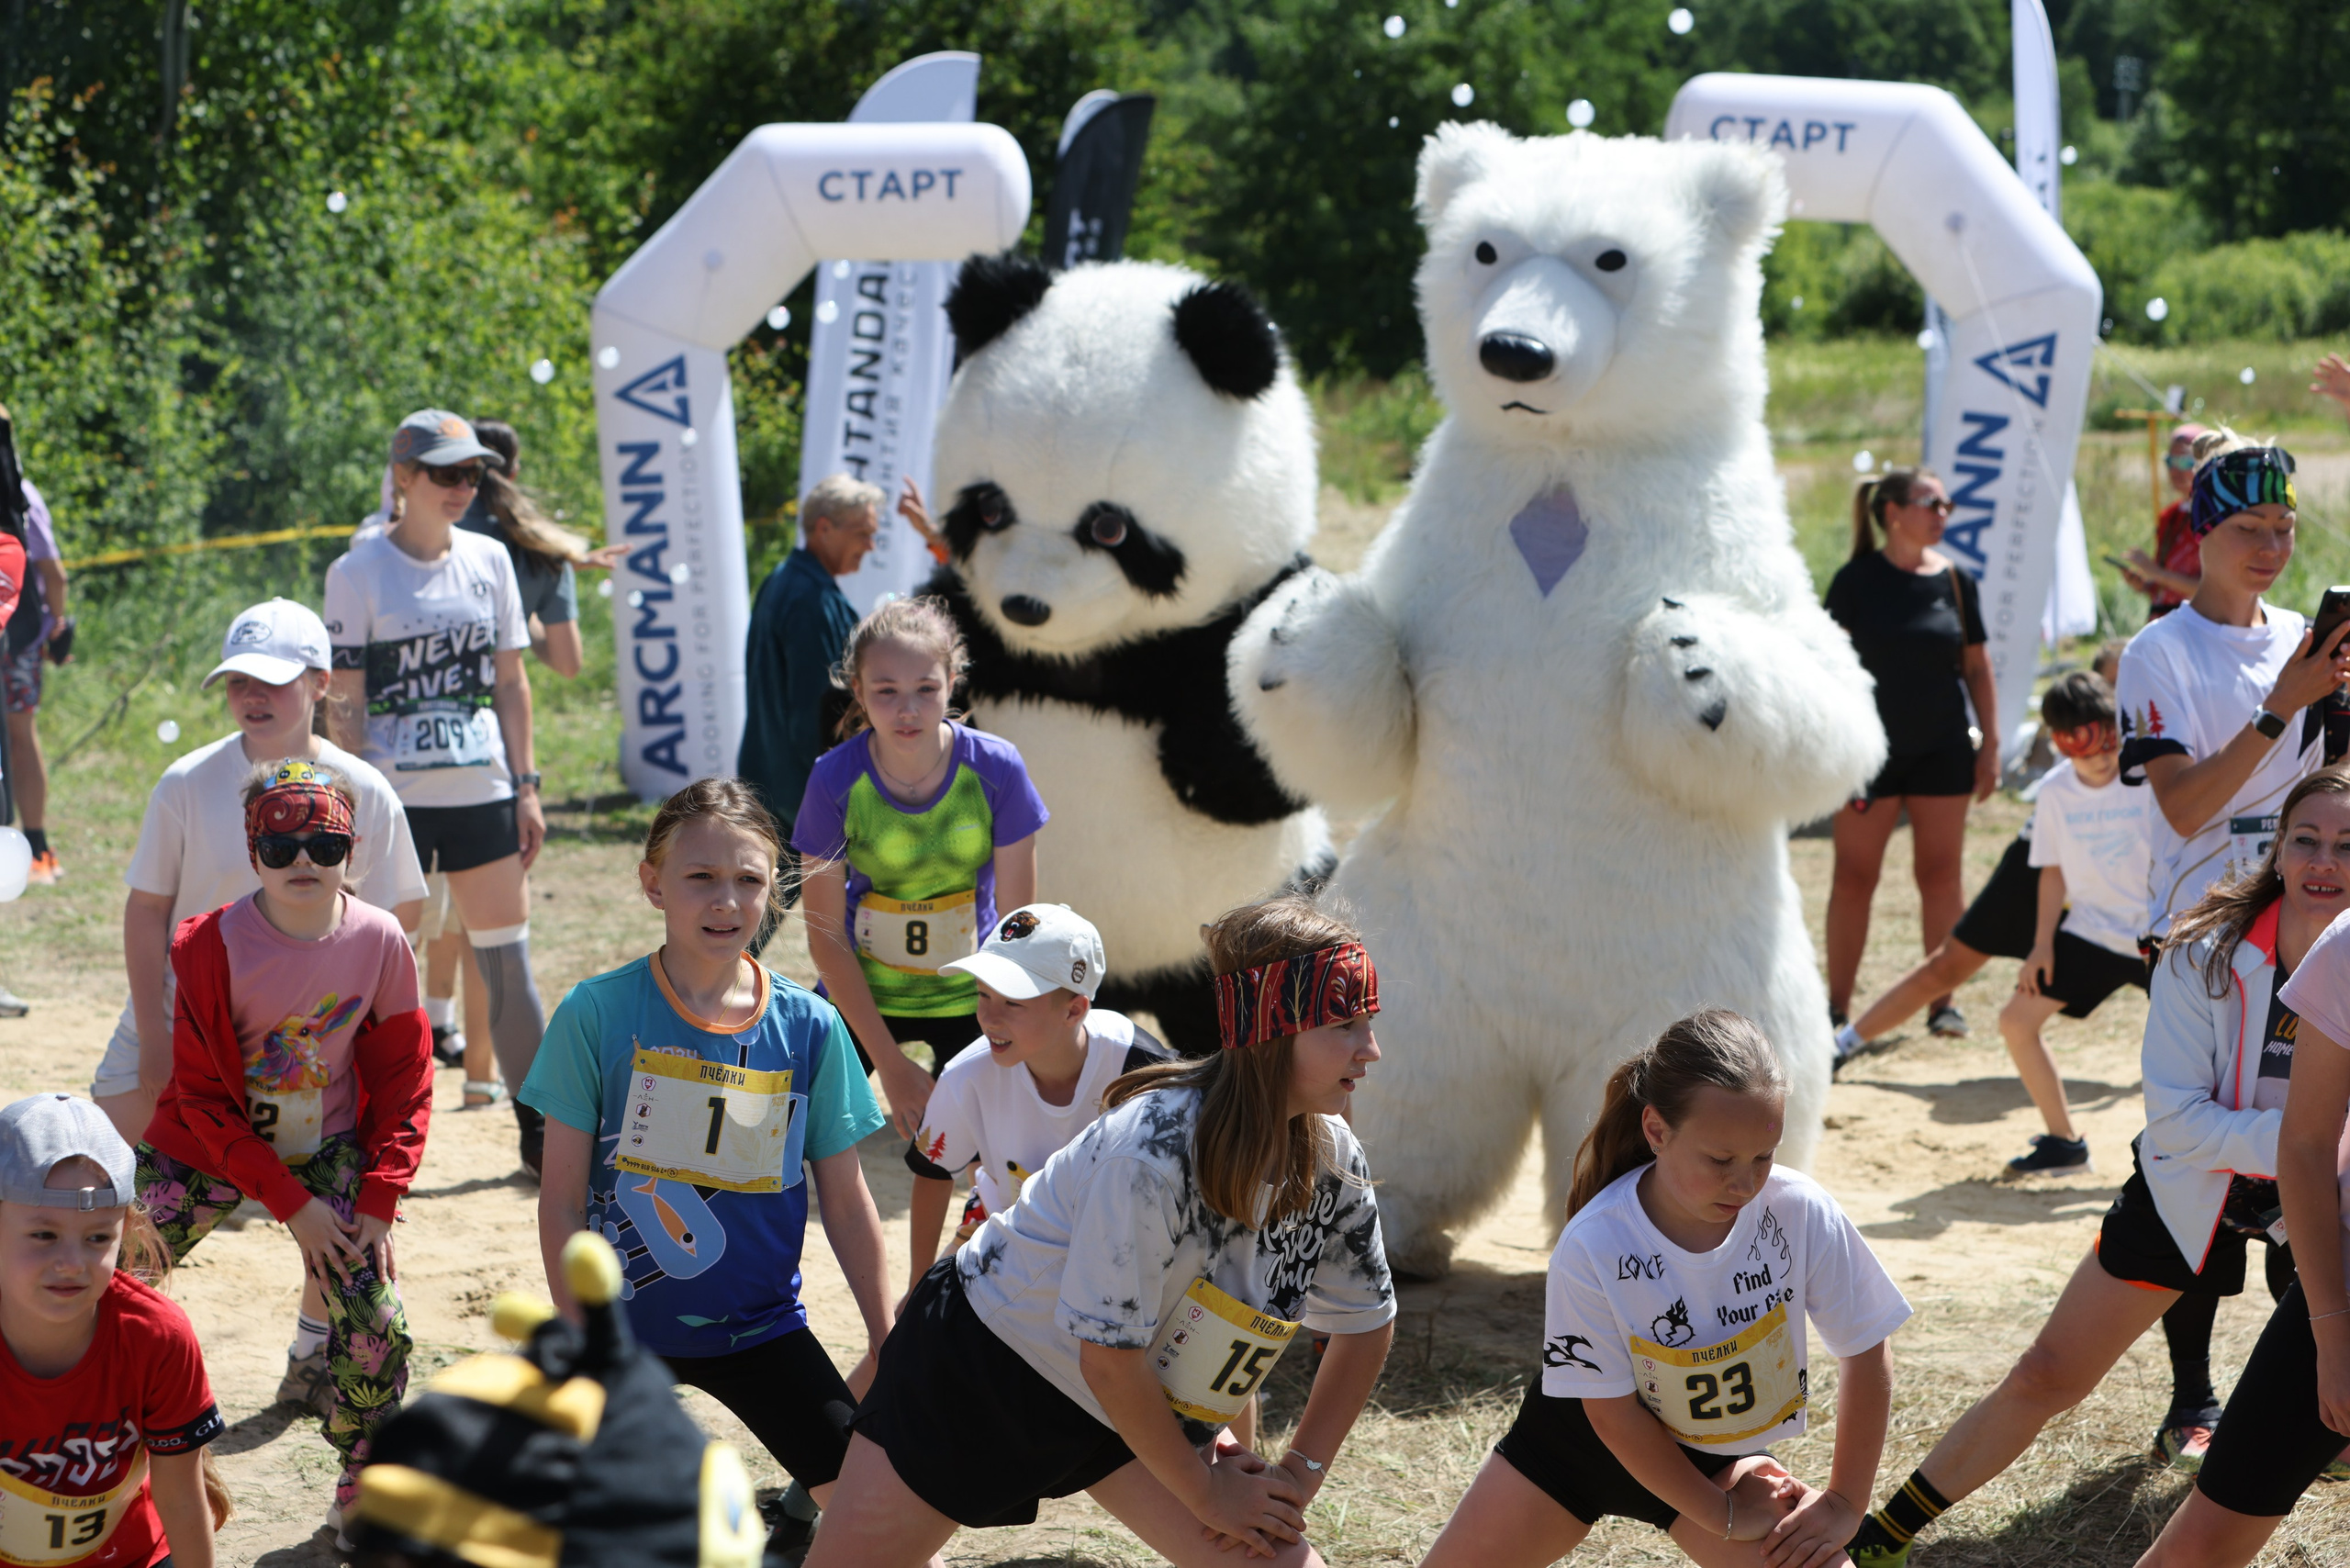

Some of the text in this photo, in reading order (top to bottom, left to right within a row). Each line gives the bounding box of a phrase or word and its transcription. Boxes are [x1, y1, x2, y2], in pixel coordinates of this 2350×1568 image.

[1710, 116, 1856, 153] СТАРТ
[818, 169, 964, 202] СТАРТ
[844, 261, 892, 481] HTANDA
[1943, 410, 2010, 582] ANN
[617, 442, 689, 778] ARCMANN
[692, 604, 712, 655] FOR
[415, 716, 464, 752] 209
[698, 662, 722, 775] LOOKING
[905, 920, 928, 956] 8
[699, 1065, 746, 1087] ПЧЁЛКИ
[704, 1096, 727, 1155] 1
[1617, 1252, 1666, 1281] LOVE
[1249, 1315, 1292, 1338] ПЧЁЛКИ
[1717, 1304, 1759, 1327] Your
[1209, 1338, 1279, 1397] 15
[1691, 1340, 1738, 1363] ПЧЁЛКИ
[1685, 1361, 1755, 1419] 23
[45, 1508, 107, 1550] 13
